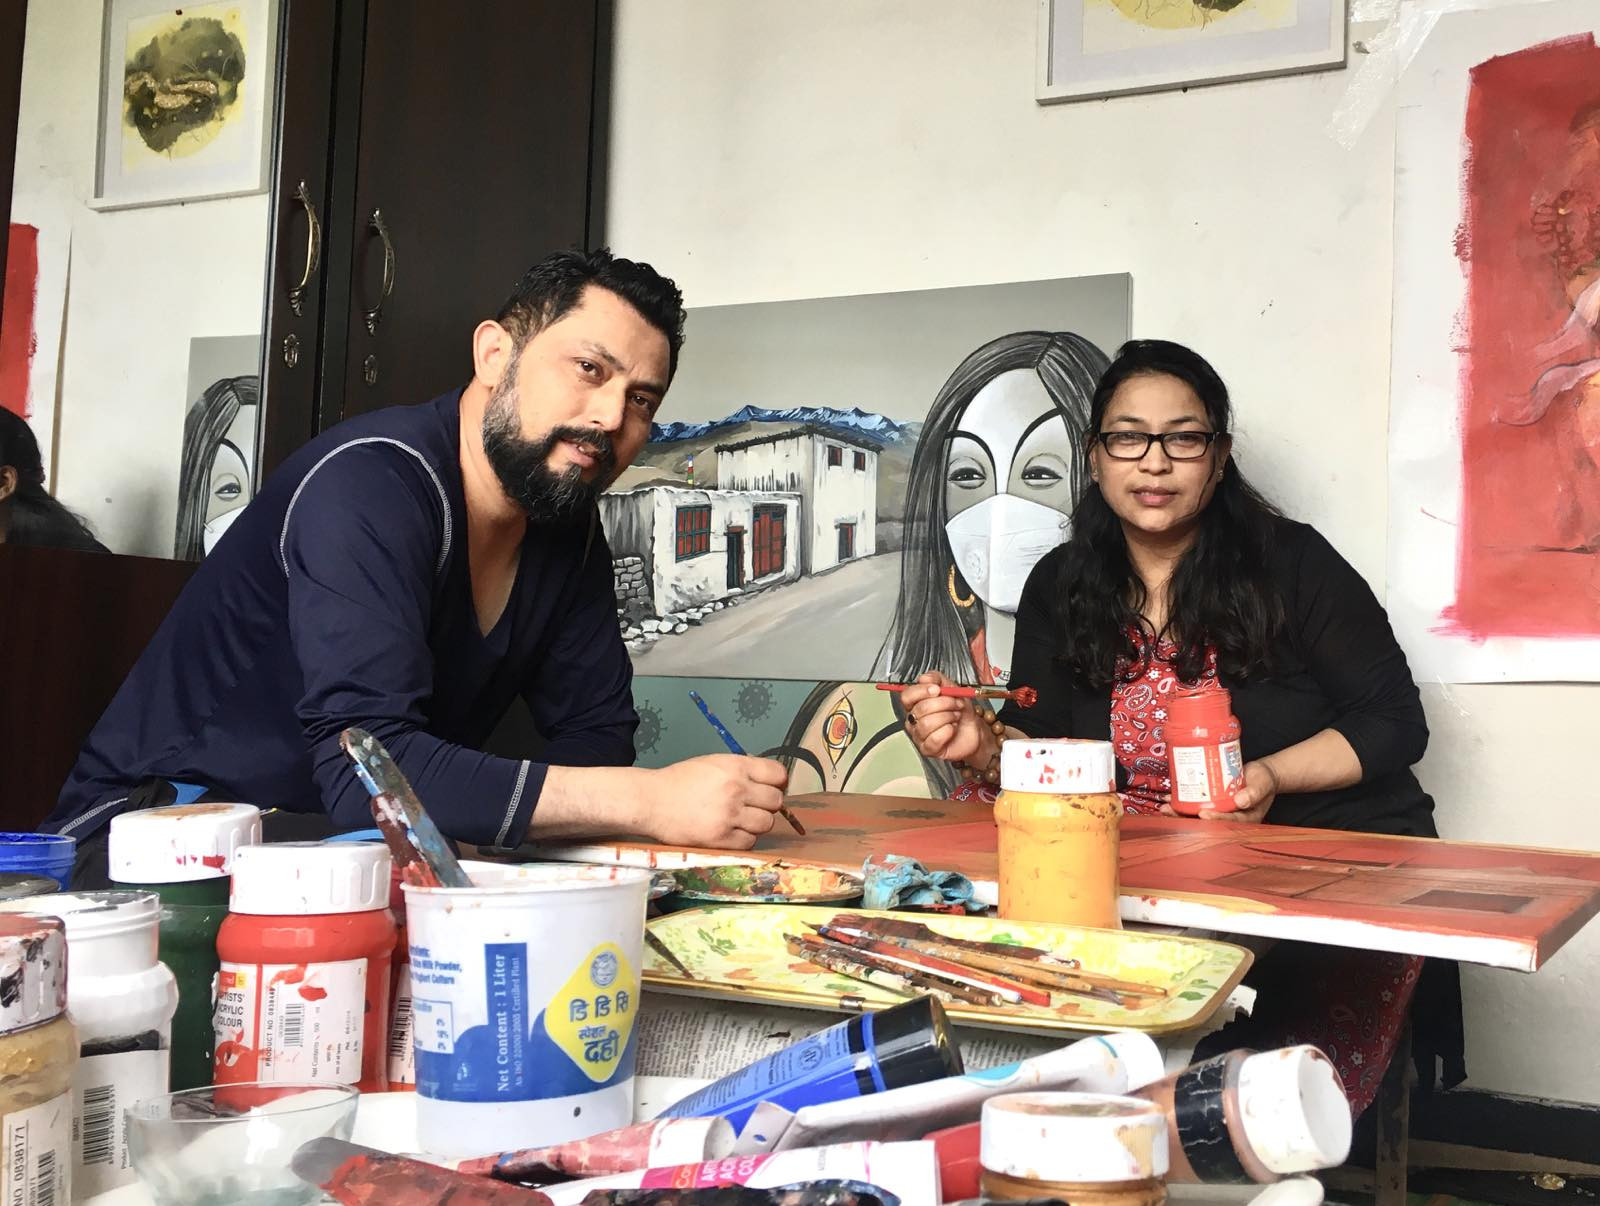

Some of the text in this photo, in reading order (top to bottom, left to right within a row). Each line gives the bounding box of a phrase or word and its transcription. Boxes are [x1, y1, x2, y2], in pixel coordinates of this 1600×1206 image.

[493, 954, 506, 986] Liter
[265, 1032, 273, 1067] PRODUCT
[496, 1012, 509, 1065] Content
[584, 1030, 620, 1063] दही
[497, 1069, 509, 1091] Net
[14, 1126, 25, 1182] 0838171
